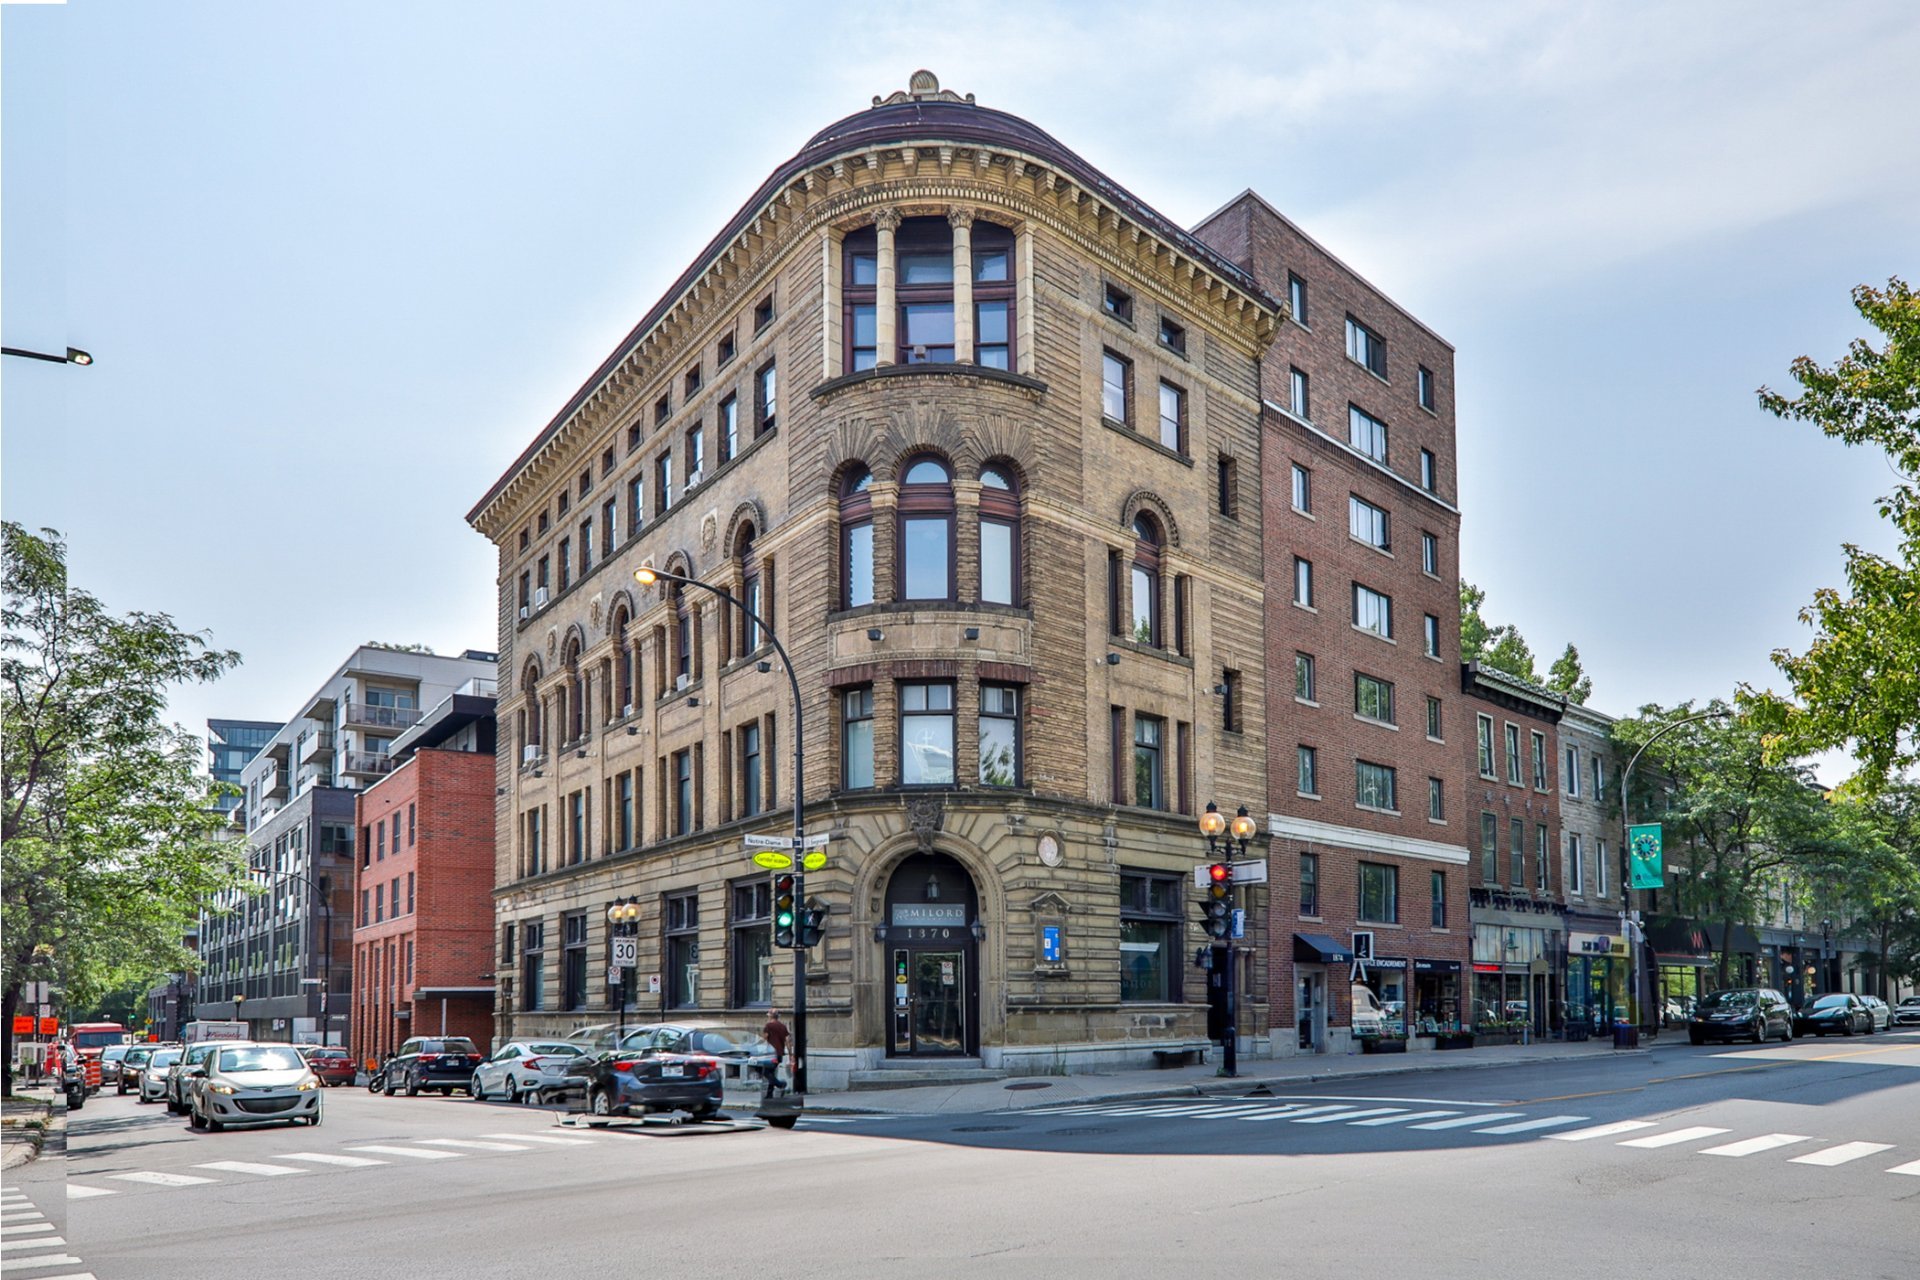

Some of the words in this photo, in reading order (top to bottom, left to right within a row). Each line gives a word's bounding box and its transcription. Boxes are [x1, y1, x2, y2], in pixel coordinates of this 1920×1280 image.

[747, 838, 782, 846] Notre-Dame
[910, 908, 964, 918] MILORD
[616, 944, 635, 959] 30
